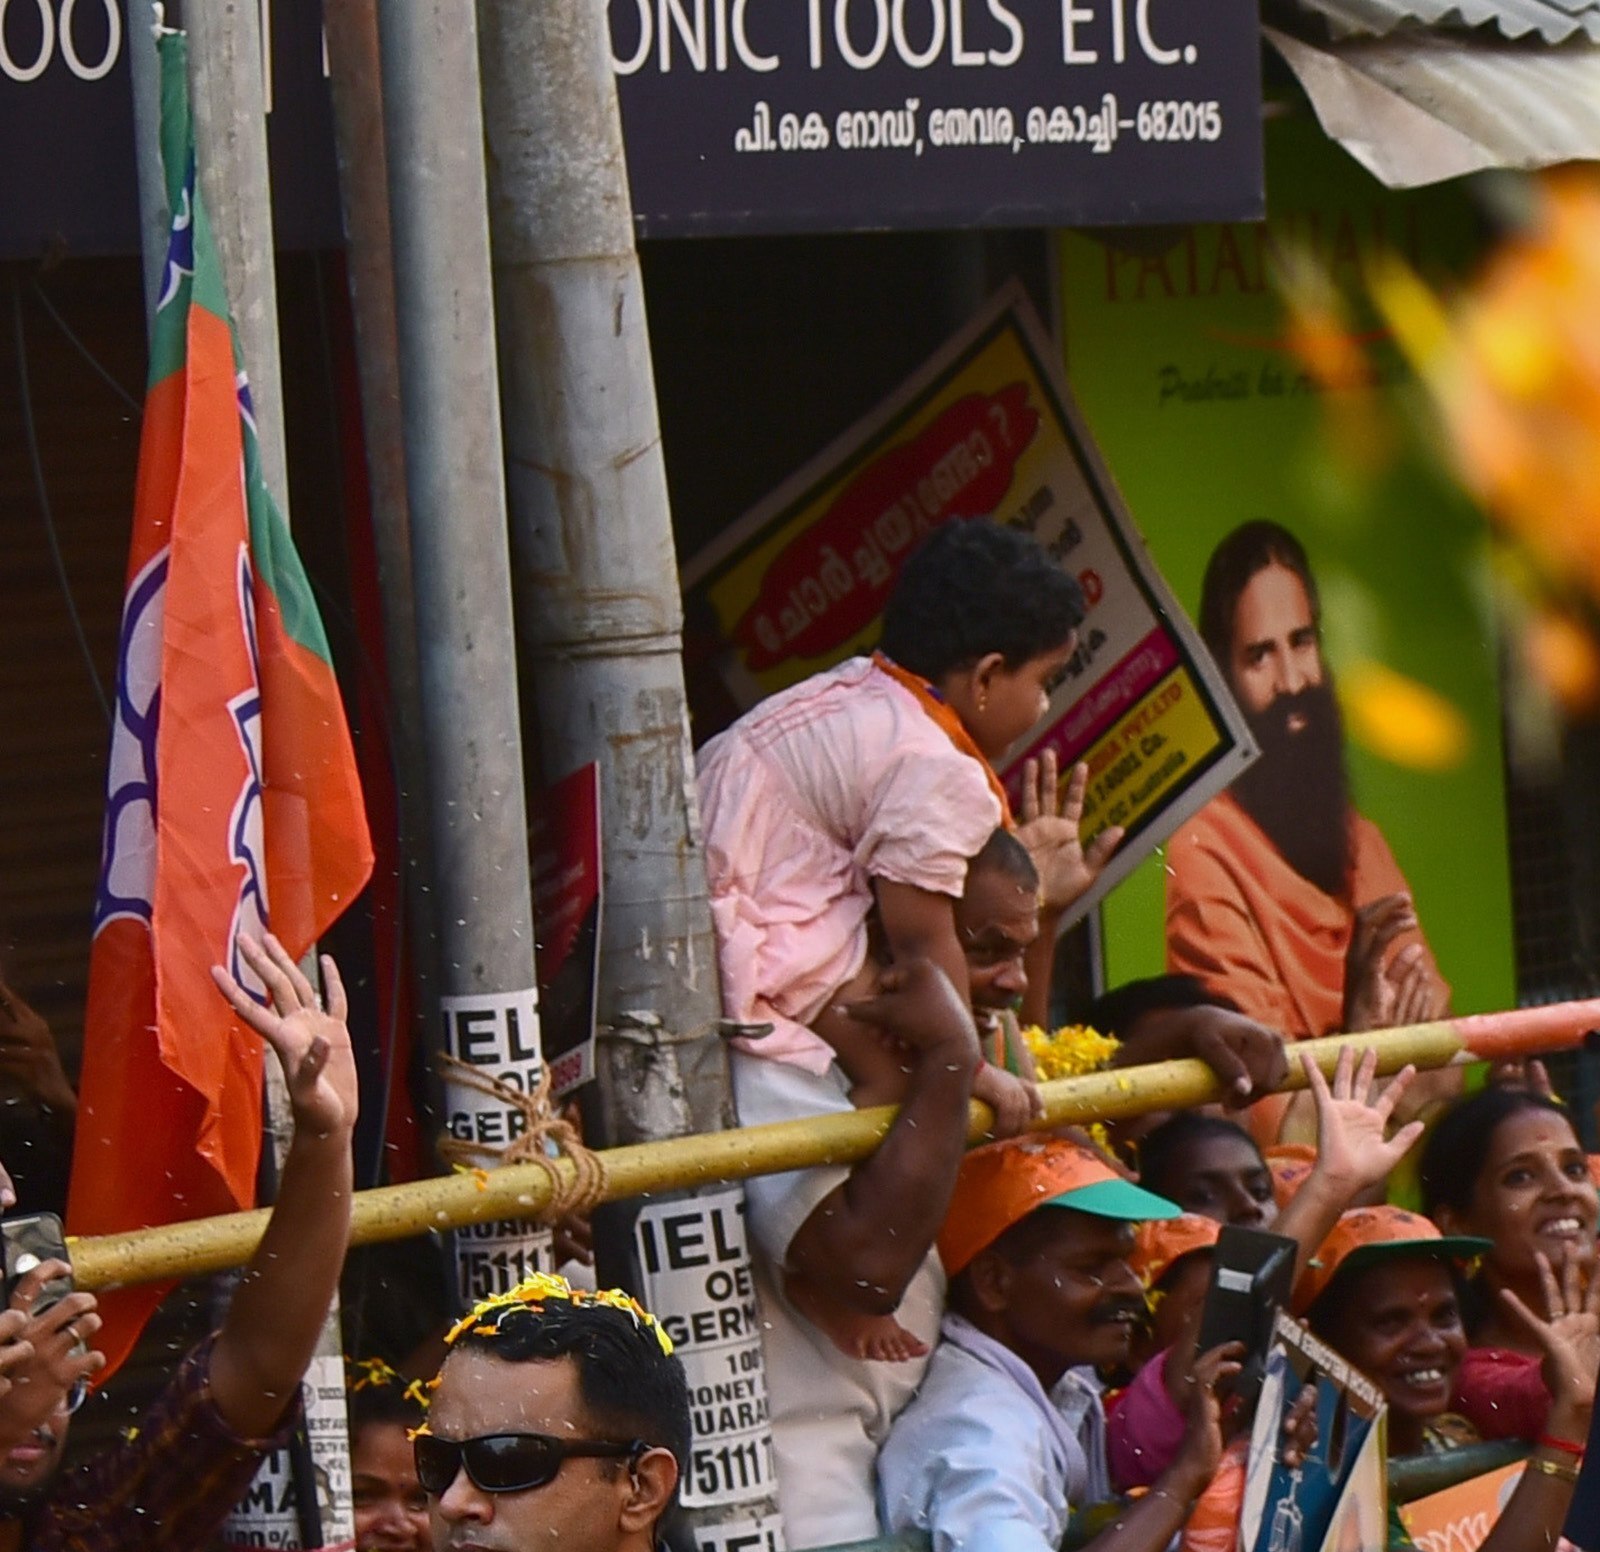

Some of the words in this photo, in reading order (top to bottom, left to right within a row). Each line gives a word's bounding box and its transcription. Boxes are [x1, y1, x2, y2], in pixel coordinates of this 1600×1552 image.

[1064, 0, 1197, 64] ETC.
[443, 1007, 541, 1066] IEL
[640, 1202, 746, 1275] IEL
